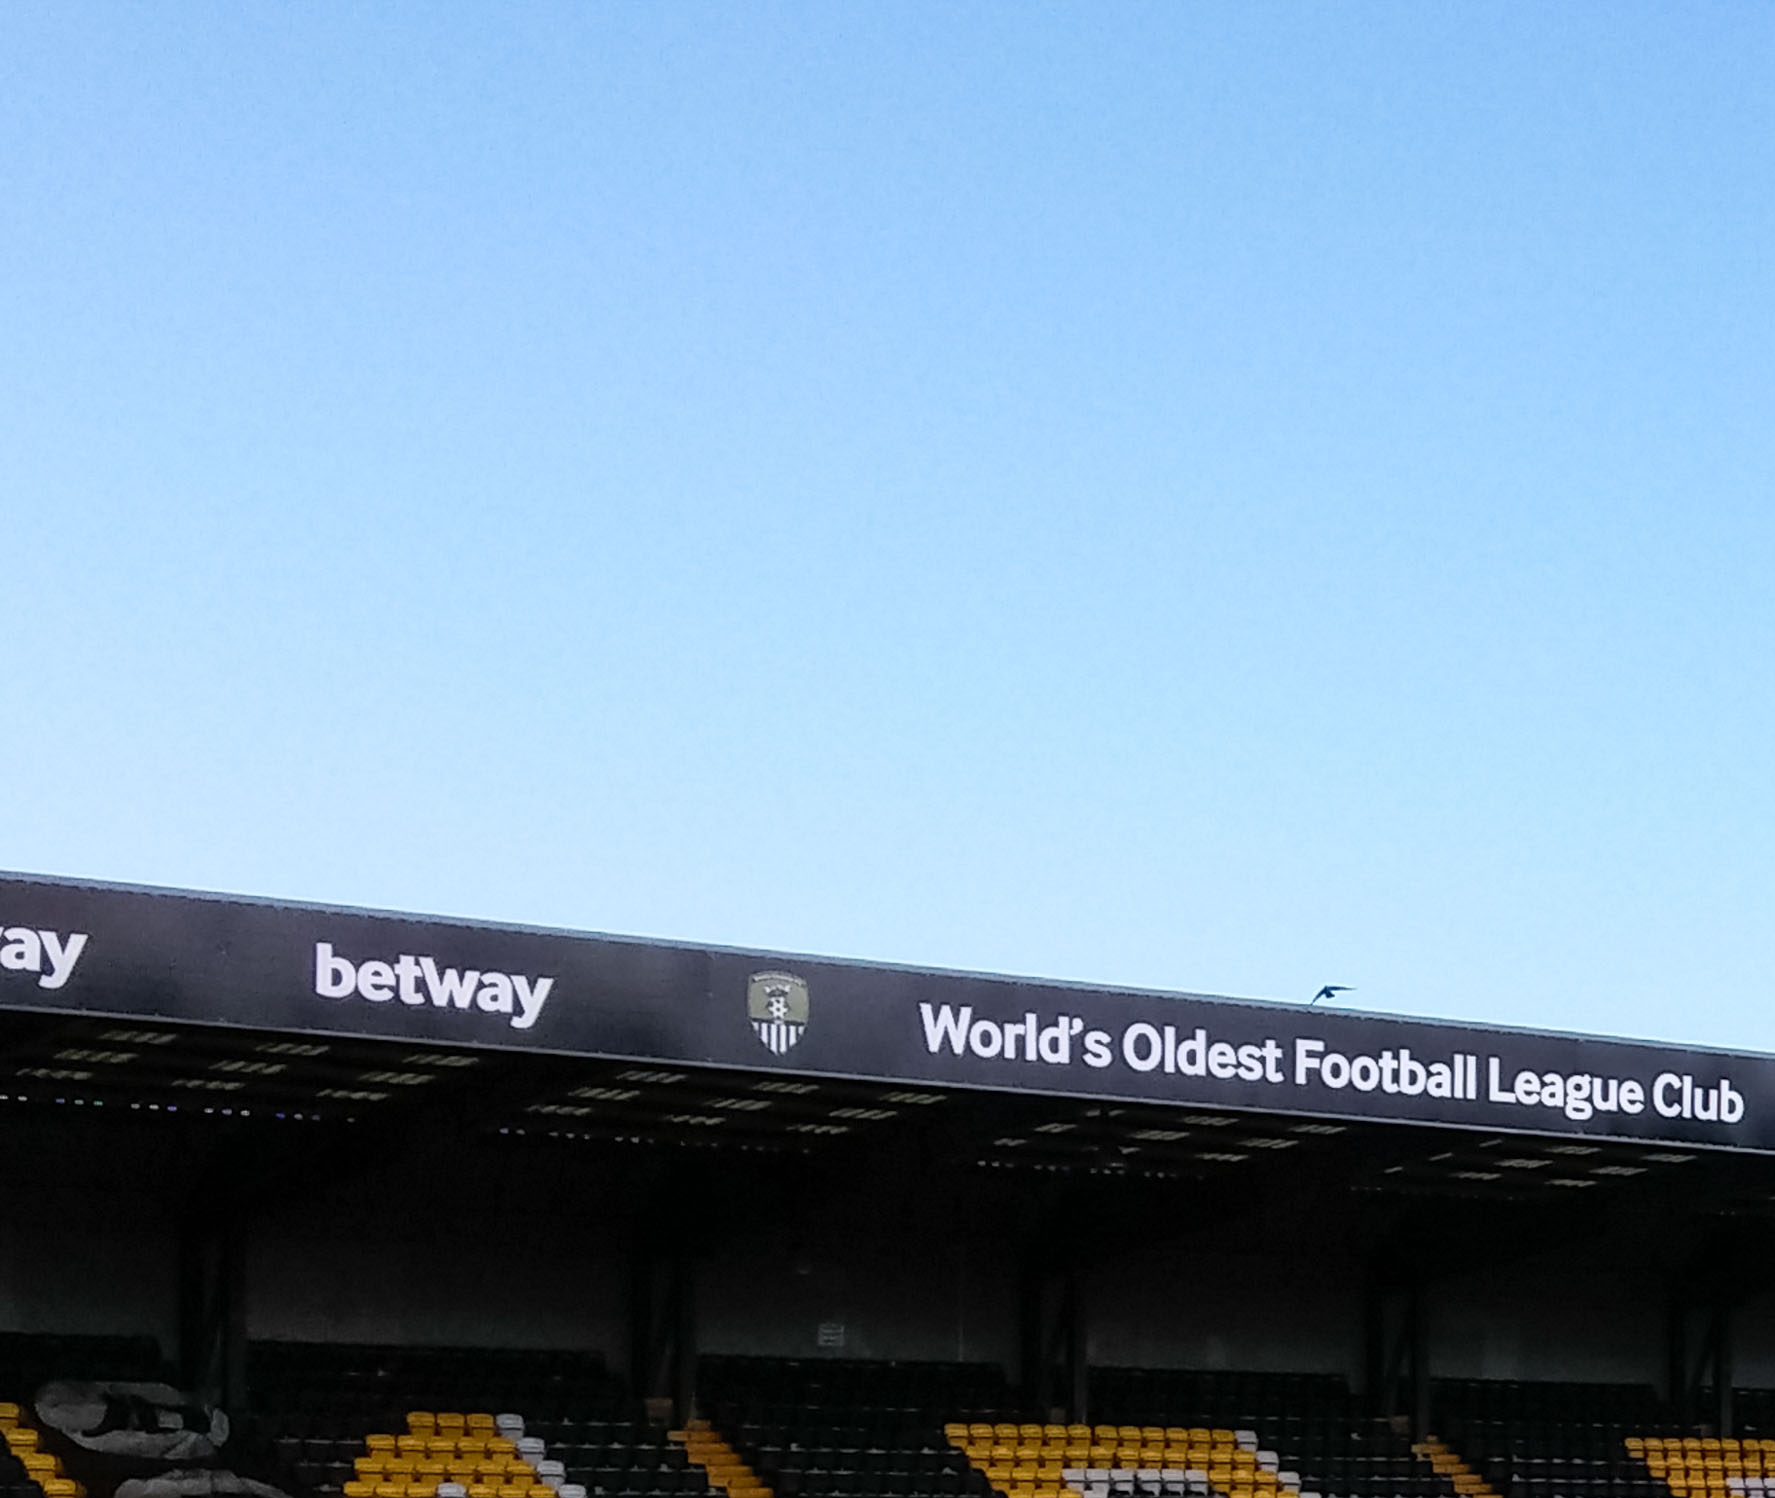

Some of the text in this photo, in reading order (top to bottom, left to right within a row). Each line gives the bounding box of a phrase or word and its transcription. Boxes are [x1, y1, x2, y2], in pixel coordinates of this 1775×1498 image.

[314, 943, 554, 1029] betway
[921, 1003, 1745, 1125] World's Oldest Football League Club
